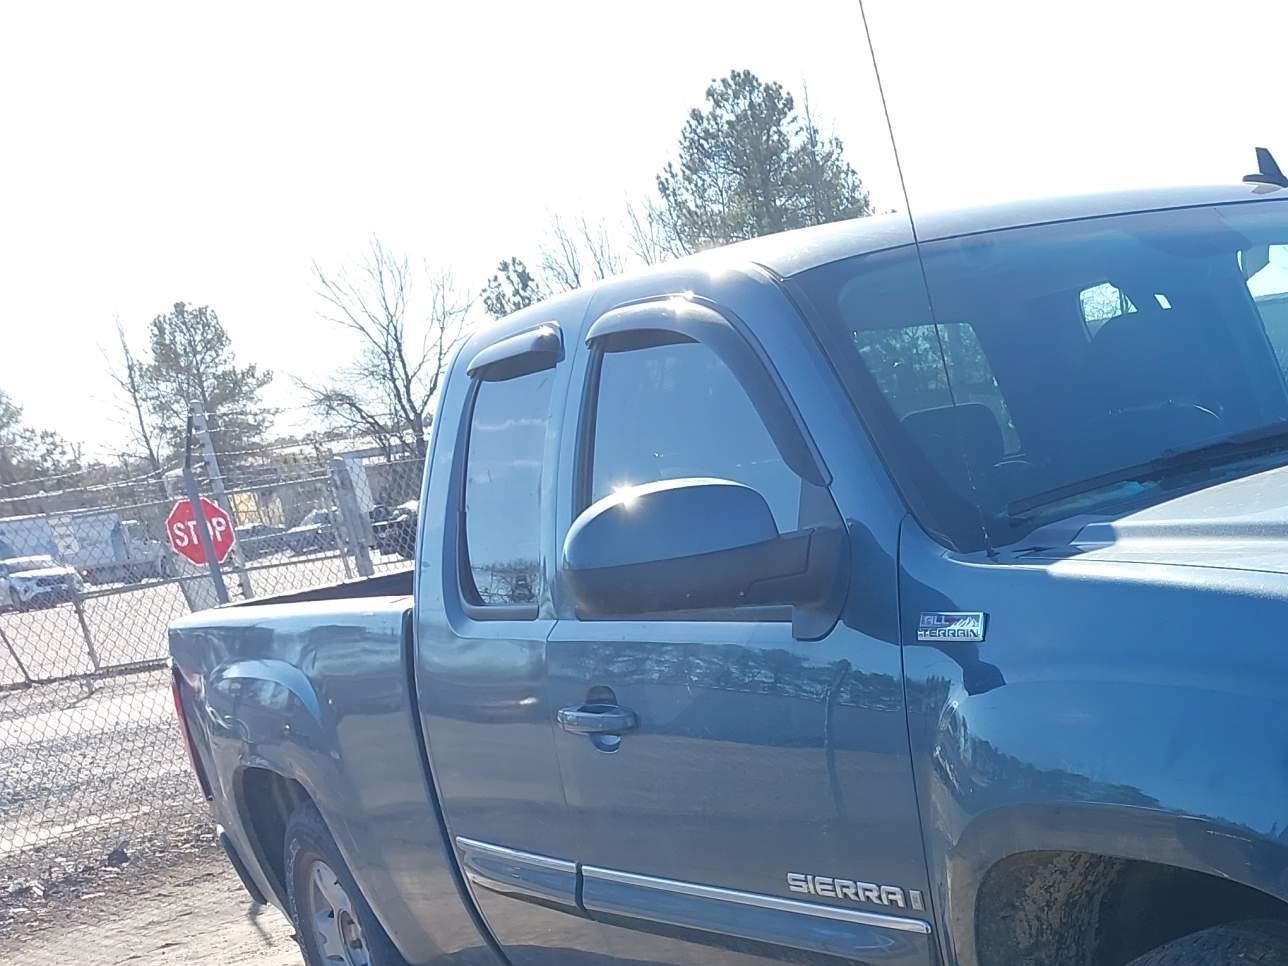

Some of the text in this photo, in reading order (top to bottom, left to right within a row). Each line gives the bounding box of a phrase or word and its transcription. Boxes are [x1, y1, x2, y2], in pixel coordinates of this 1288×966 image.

[924, 616, 950, 624] ALL
[920, 628, 978, 637] TERRAIN
[787, 872, 905, 908] SIERRA
